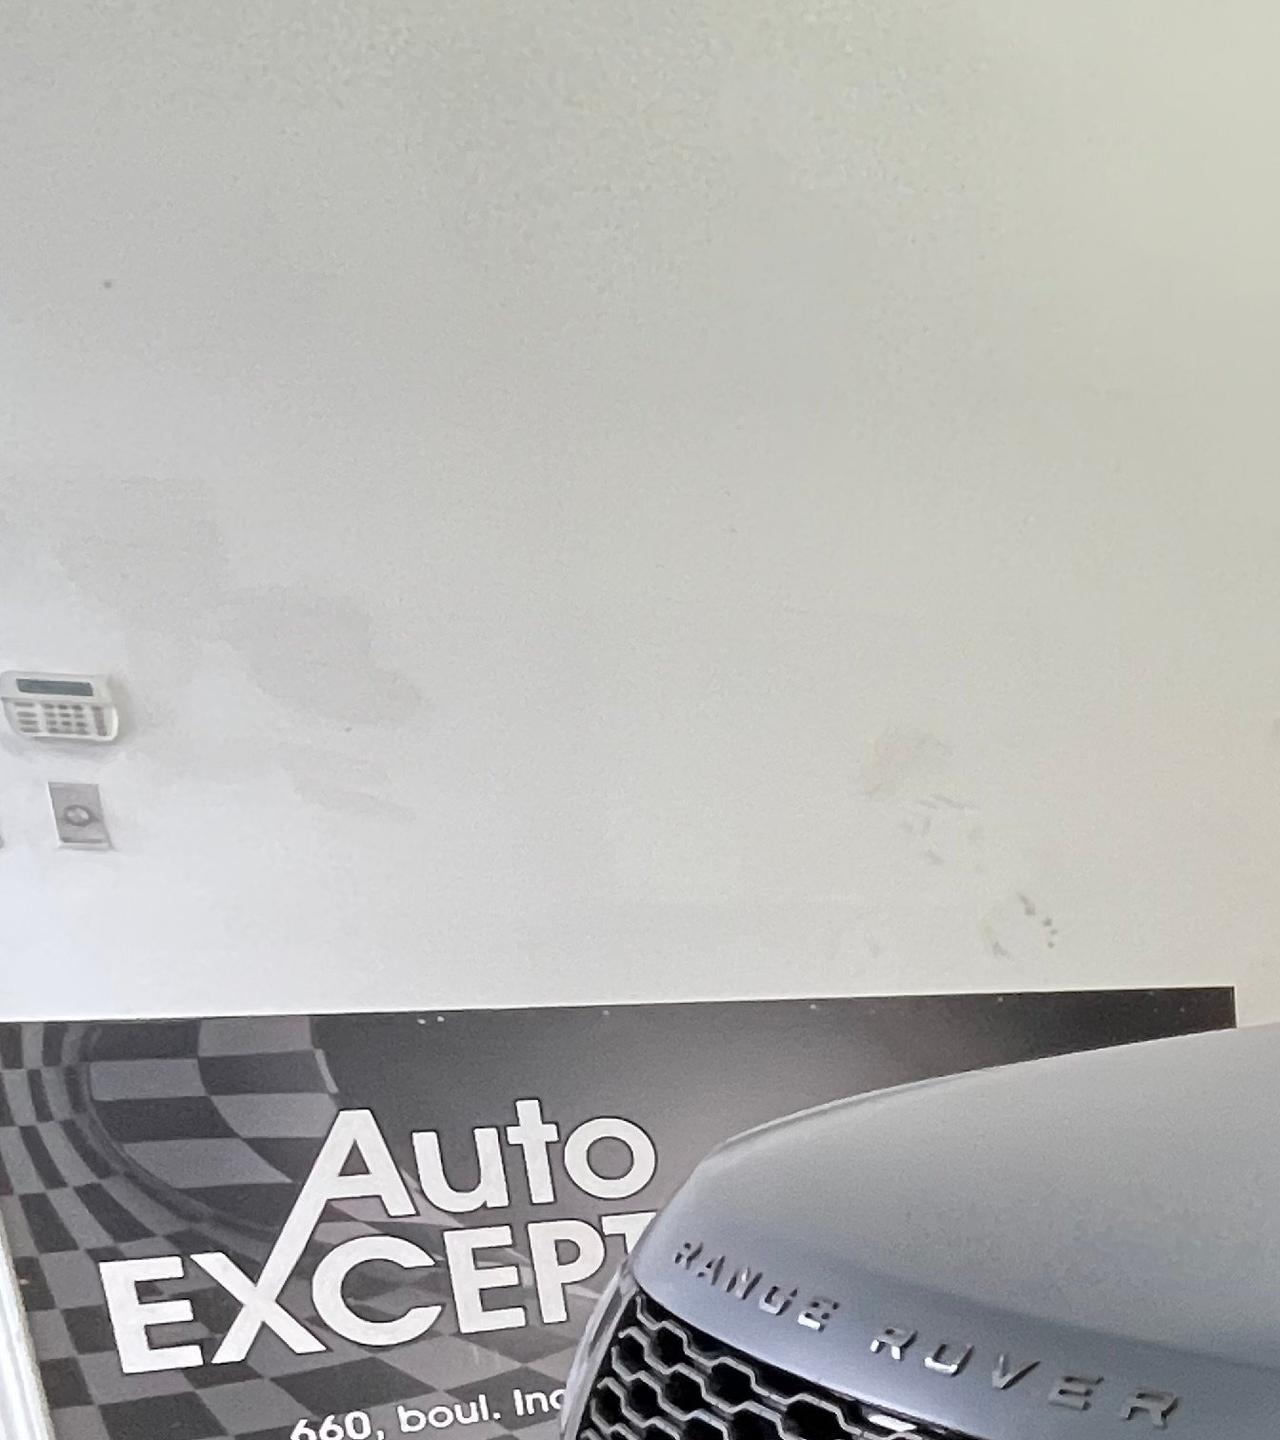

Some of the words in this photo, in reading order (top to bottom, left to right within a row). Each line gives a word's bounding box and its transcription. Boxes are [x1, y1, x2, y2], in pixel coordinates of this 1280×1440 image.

[305, 1099, 657, 1218] Auto
[674, 1241, 839, 1332] RANGE
[870, 1326, 1179, 1430] ROVER
[397, 1393, 502, 1433] boul.
